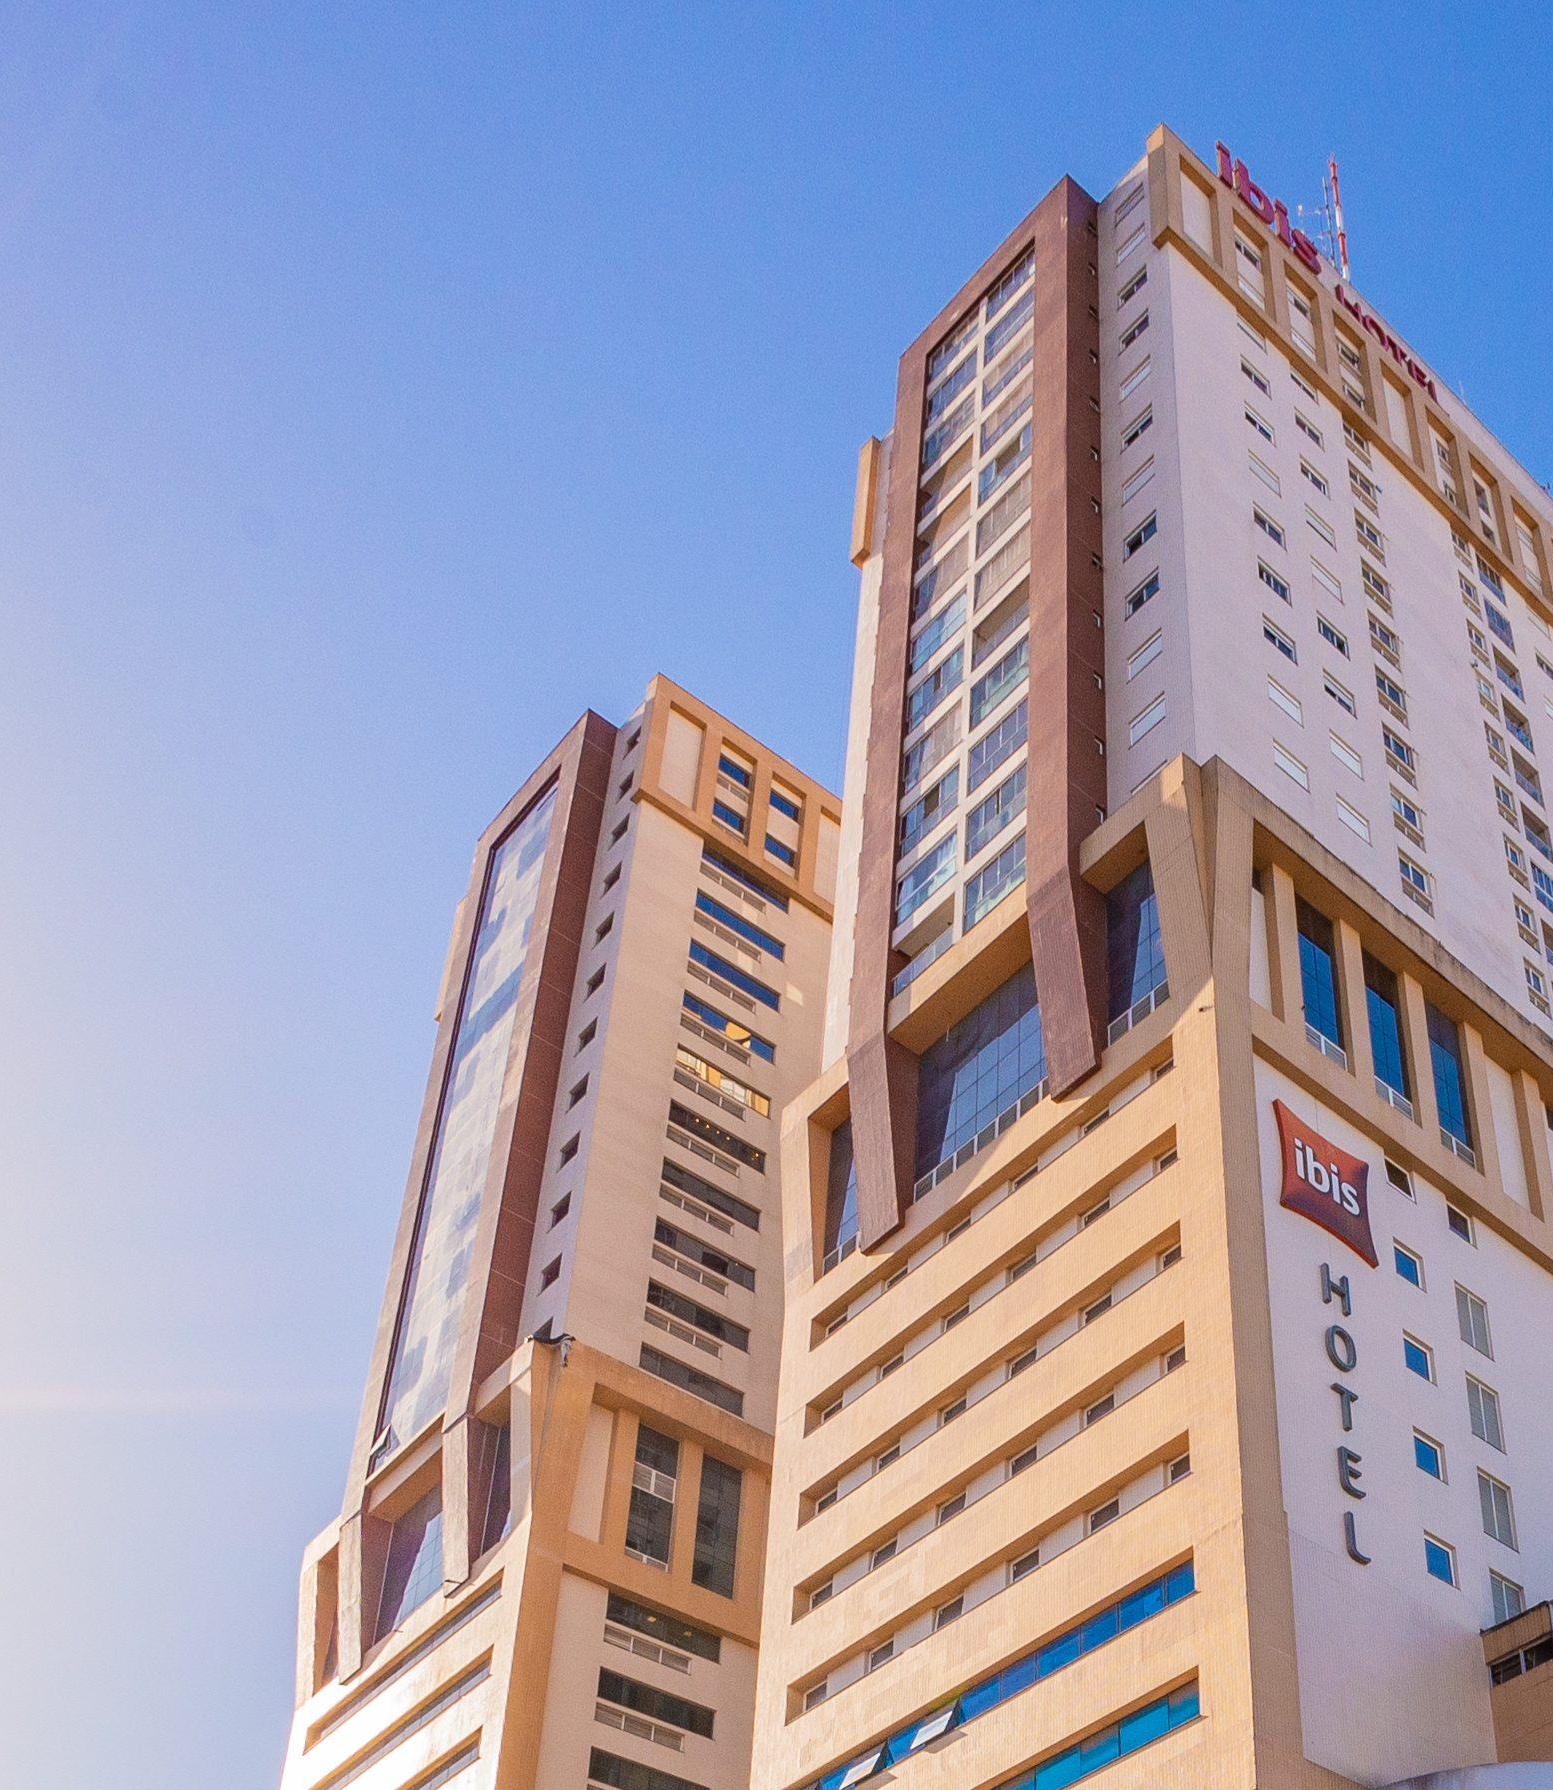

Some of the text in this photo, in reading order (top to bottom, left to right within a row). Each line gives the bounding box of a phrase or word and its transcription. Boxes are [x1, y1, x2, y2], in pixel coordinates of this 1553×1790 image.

[1216, 140, 1322, 276] ibis
[1294, 1137, 1361, 1218] ibis
[1320, 1262, 1372, 1566] HOTEL
